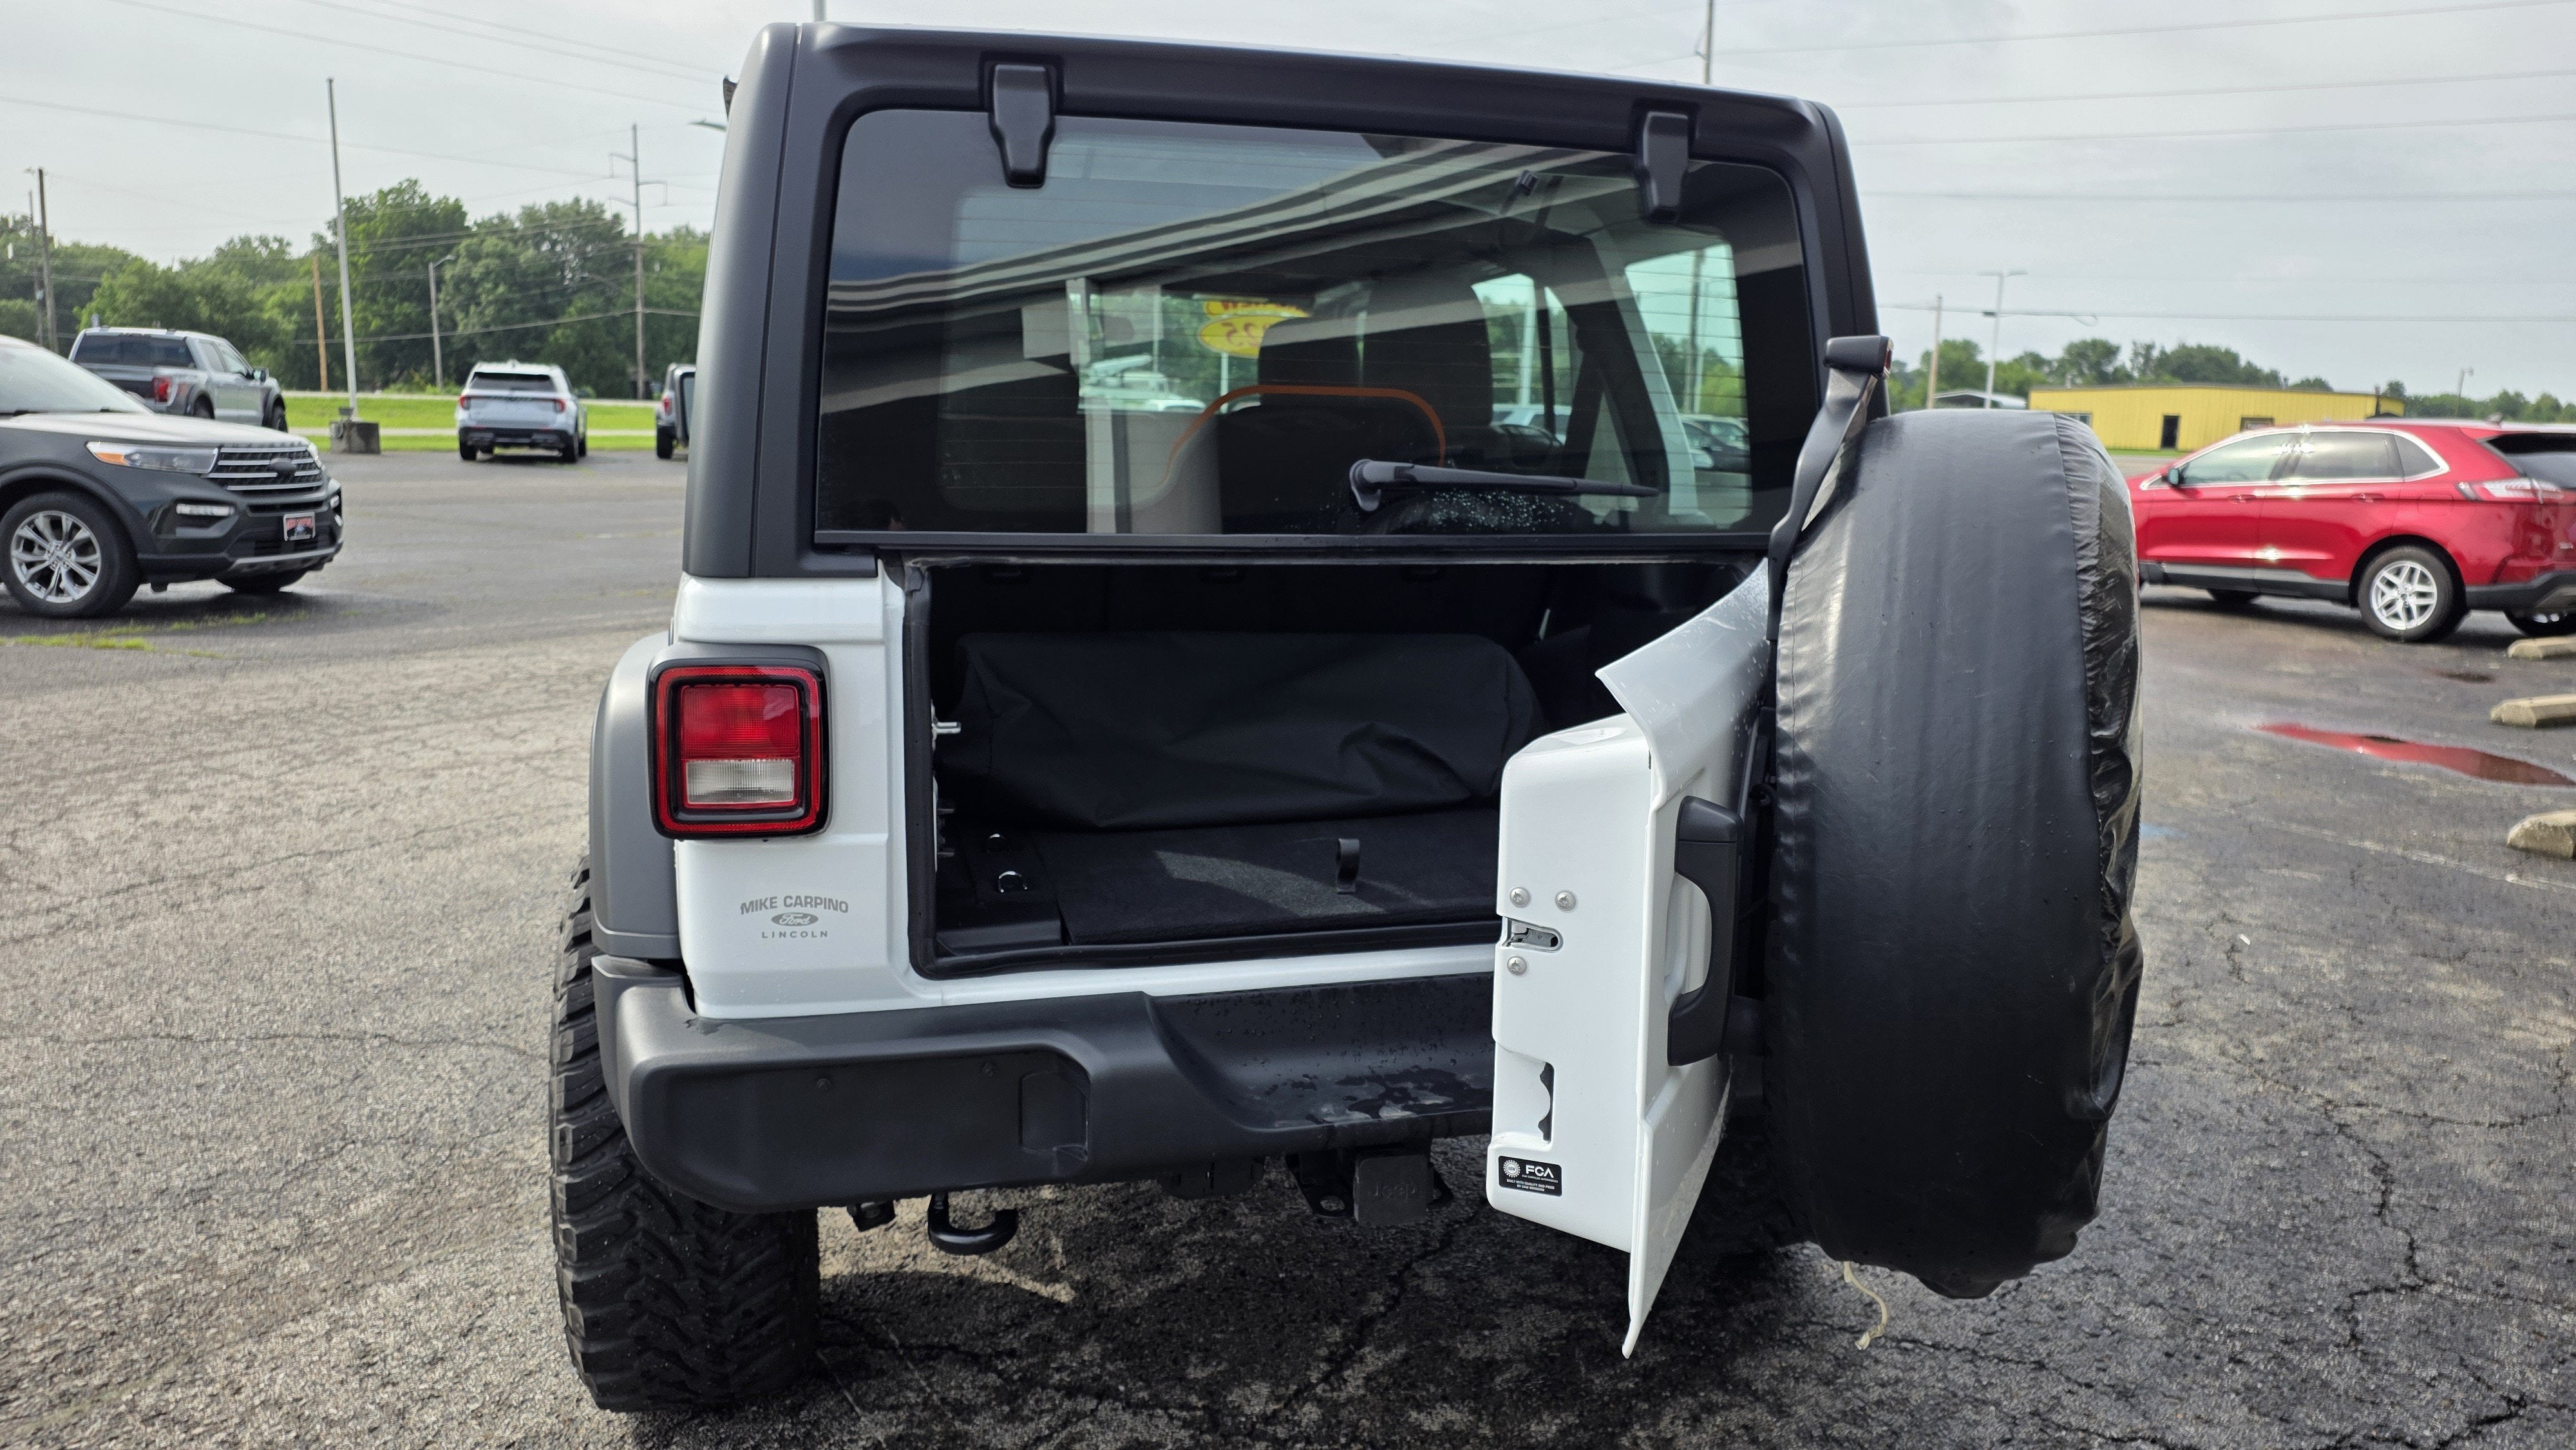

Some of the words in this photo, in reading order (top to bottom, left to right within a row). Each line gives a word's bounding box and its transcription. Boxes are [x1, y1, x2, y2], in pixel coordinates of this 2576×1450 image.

[741, 896, 777, 914] MIKE
[783, 896, 848, 913] CARPINO
[779, 914, 810, 925] Ford
[1526, 1165, 1554, 1178] FCA
